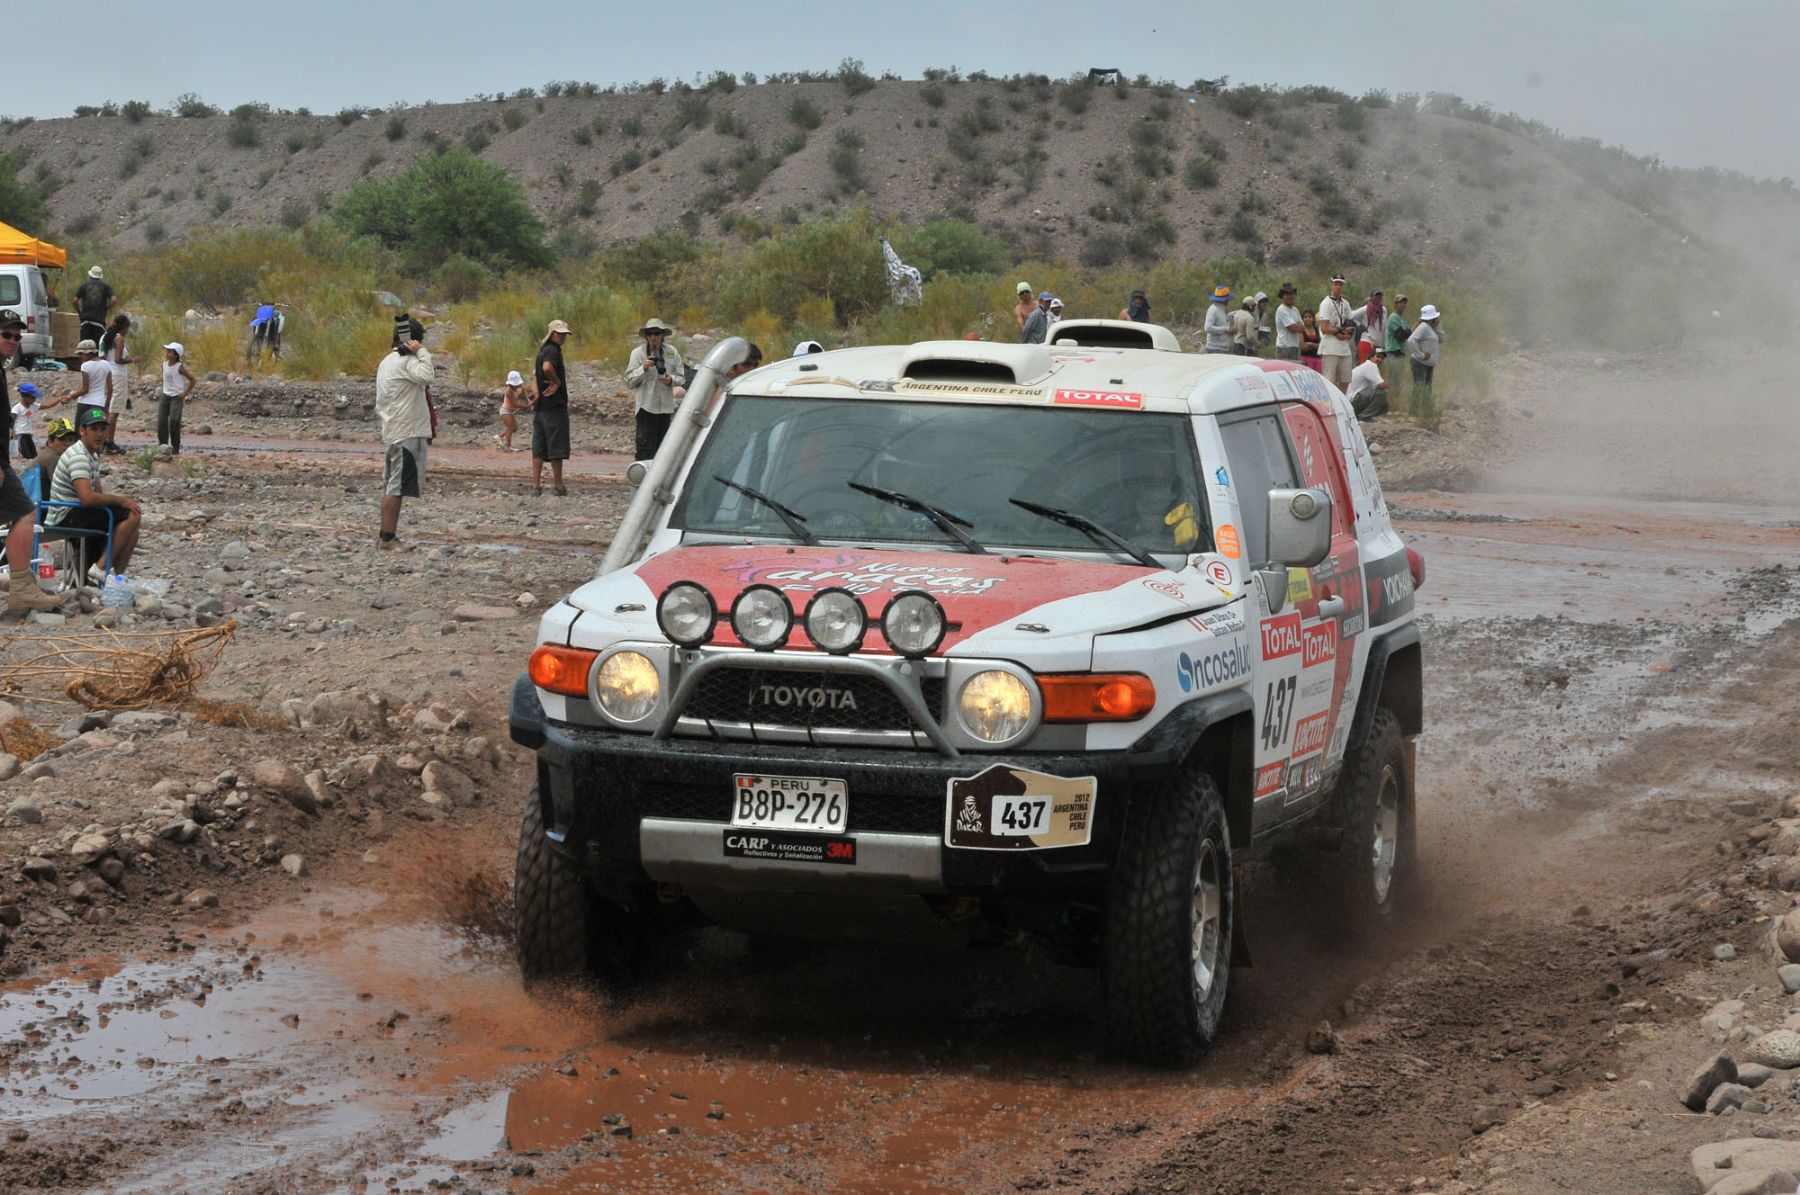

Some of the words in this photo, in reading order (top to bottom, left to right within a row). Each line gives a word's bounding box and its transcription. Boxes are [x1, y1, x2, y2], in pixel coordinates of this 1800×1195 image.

[902, 382, 969, 392] ARGENTINA
[1058, 390, 1139, 402] TOTAL
[1213, 567, 1226, 581] E
[1261, 623, 1301, 655] TOTAL
[1303, 631, 1335, 662] TOTAL
[760, 685, 857, 710] TOYOTA
[1261, 675, 1297, 751] 437
[770, 779, 810, 791] PERU
[1074, 793, 1090, 802] 2012
[738, 788, 841, 825] B8P-276
[1053, 803, 1088, 813] ARGENTINA
[1001, 801, 1046, 829] 437
[1069, 812, 1087, 821] CHILE
[956, 819, 984, 833] DAKAR
[1069, 821, 1086, 831] PERU
[726, 836, 769, 850] CARP
[778, 844, 823, 853] ASOCIADOS
[826, 842, 853, 859] 3M
[743, 849, 778, 858] Reflectivos
